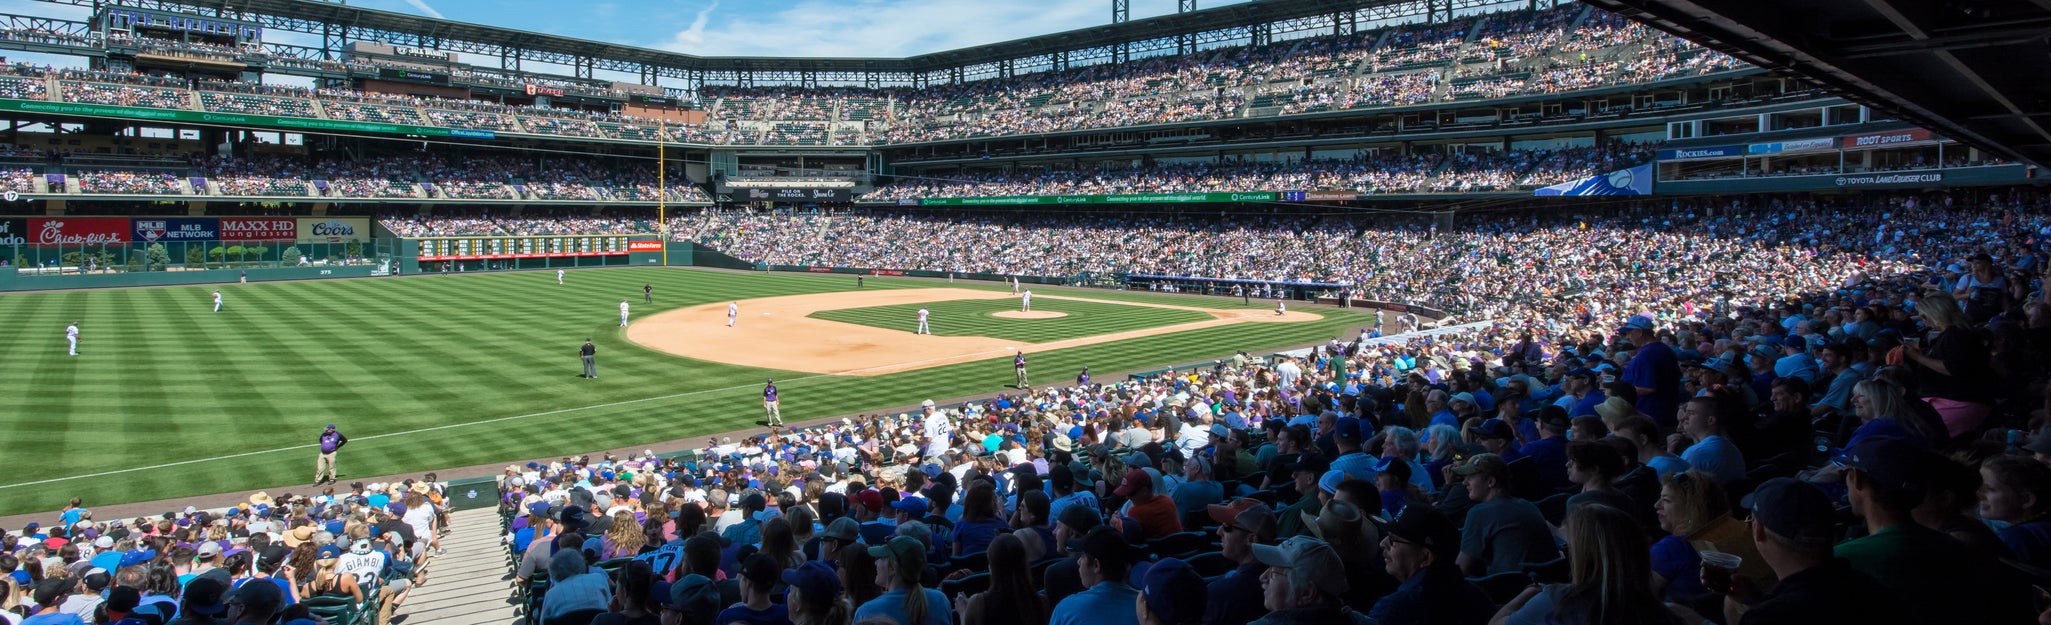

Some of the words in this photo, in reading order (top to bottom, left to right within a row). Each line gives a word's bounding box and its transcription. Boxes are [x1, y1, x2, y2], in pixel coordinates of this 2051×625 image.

[112, 9, 154, 27] THE
[169, 16, 263, 40] ROOFTOP
[408, 47, 424, 55] JACK
[20, 102, 60, 112] Connecting
[61, 105, 73, 113] you
[1857, 136, 1881, 146] ROOT
[1881, 134, 1912, 144] SPORTS
[1675, 150, 1724, 159] ROCKIES.com
[1875, 175, 1893, 184] LAND
[1893, 175, 1920, 184] CRUISER
[1920, 174, 1941, 182] CLUB
[139, 221, 164, 229] MLB
[222, 220, 270, 231] MAXX
[272, 220, 295, 231] HD
[312, 222, 355, 236] Coors
[167, 230, 214, 238] NETWORK
[937, 421, 947, 436] 22
[345, 557, 380, 571] GIAMBI
[645, 552, 676, 576] 17
